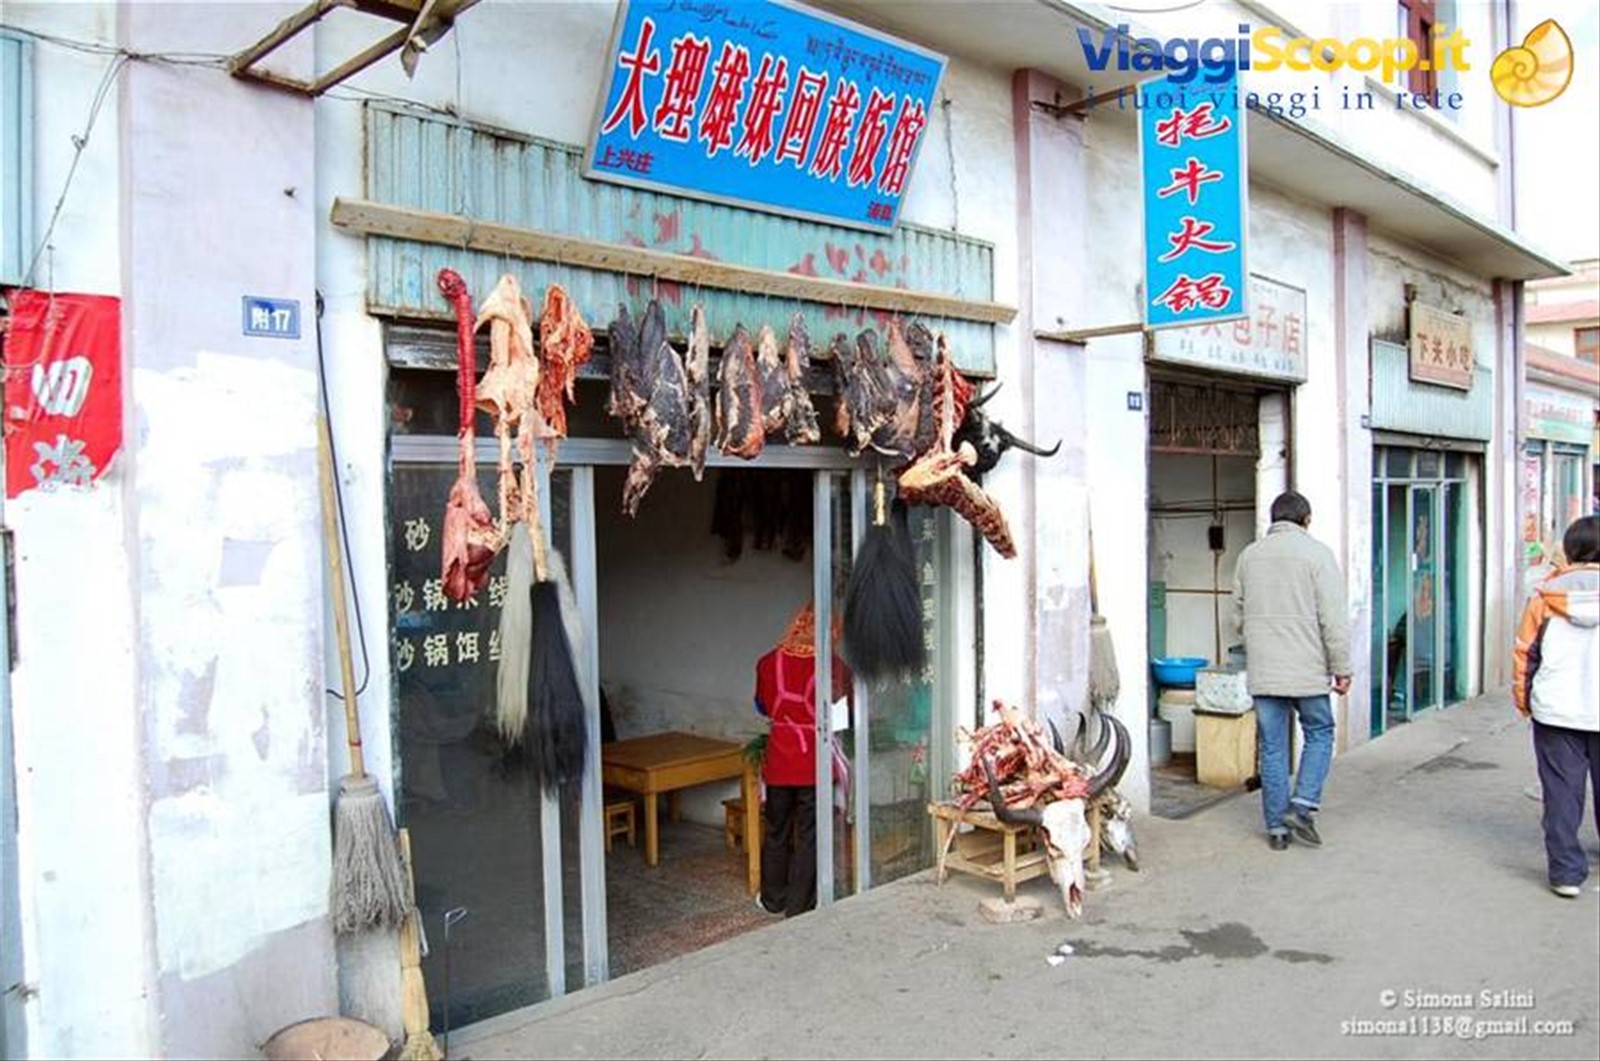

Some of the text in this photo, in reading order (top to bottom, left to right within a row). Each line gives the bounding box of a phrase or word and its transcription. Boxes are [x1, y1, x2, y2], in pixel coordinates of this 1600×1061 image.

[596, 145, 654, 174] 上兴庄
[1153, 103, 1236, 314] 牦牛火锅
[1416, 331, 1470, 373] 下关小吃
